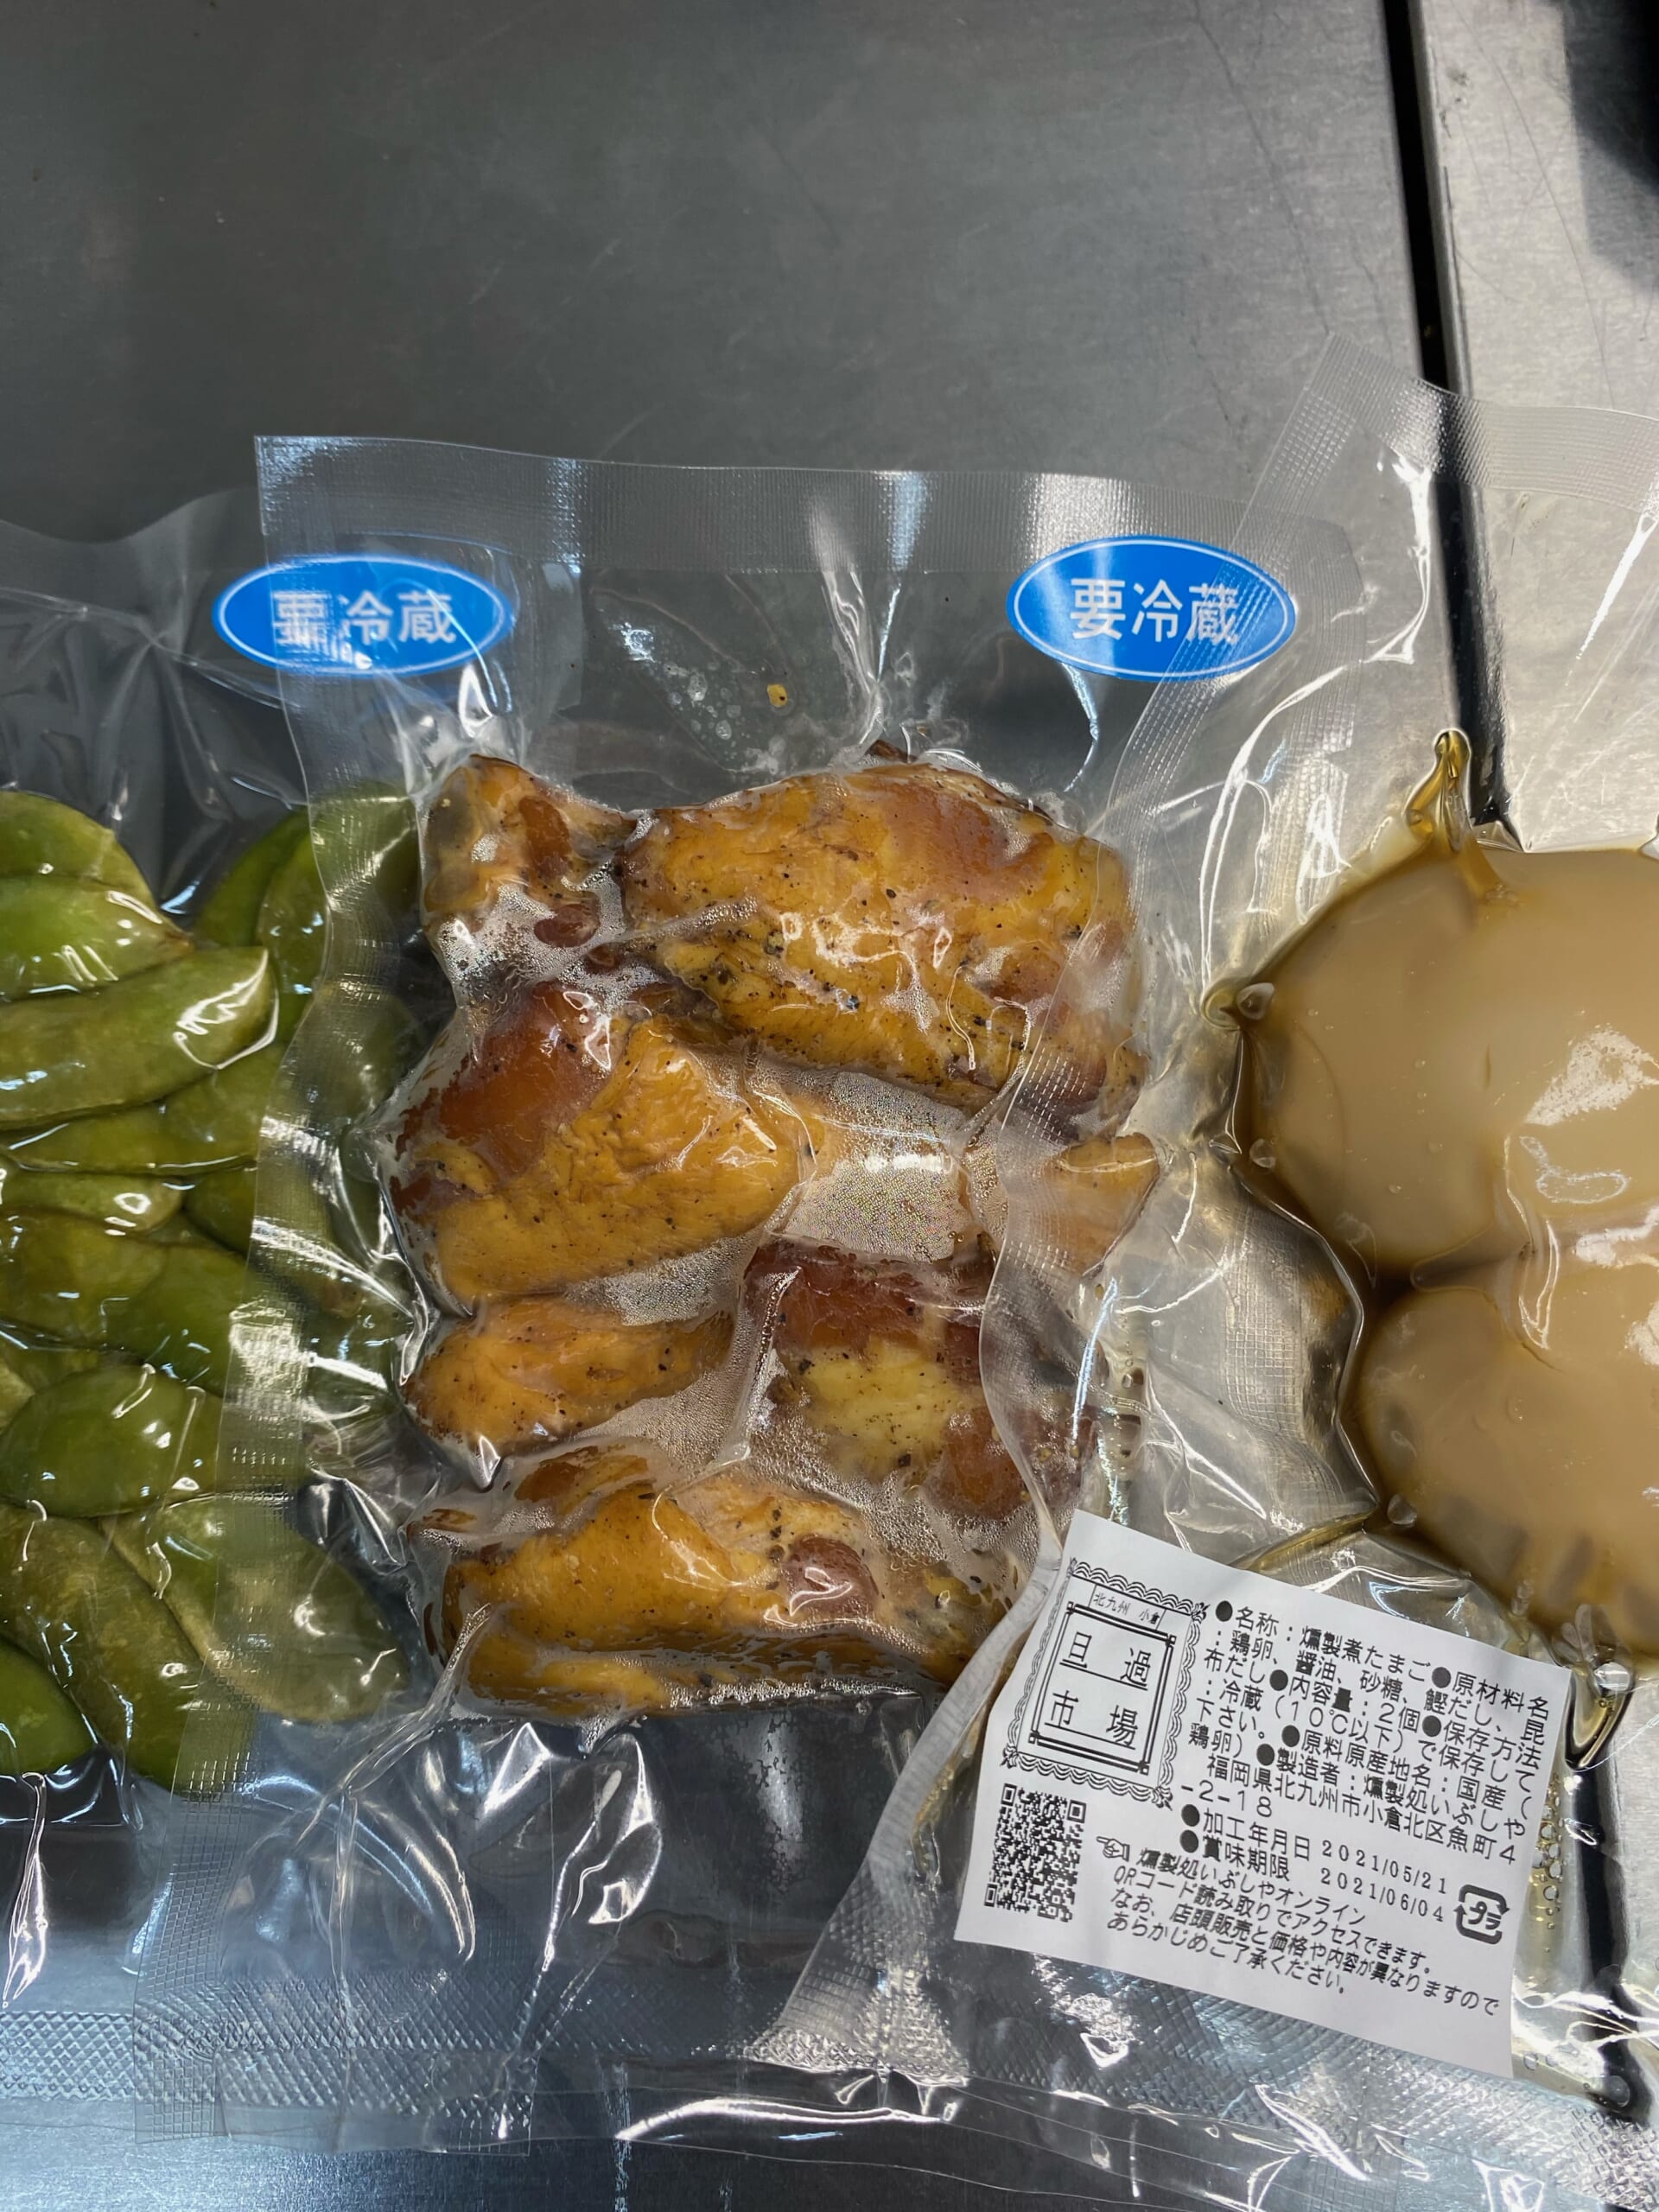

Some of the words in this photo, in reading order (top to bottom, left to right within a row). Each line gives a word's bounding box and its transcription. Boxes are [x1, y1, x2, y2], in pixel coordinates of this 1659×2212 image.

[272, 589, 455, 645] 要冷蔵
[1070, 578, 1239, 645] 要冷蔵
[1093, 1593, 1130, 1615] 北九州
[1061, 1630, 1151, 1687] 旦過
[1050, 1689, 1138, 1747] 市場
[1206, 1752, 1516, 1865] 福岡県北九州市小倉北区魚町4
[1135, 1847, 1365, 1933] 燻製処いぶしやオンライン
[1320, 1867, 1443, 1922] 2021/06/04
[1321, 1839, 1446, 1894] 2021/05/21
[1466, 1902, 1503, 1930] プラ
